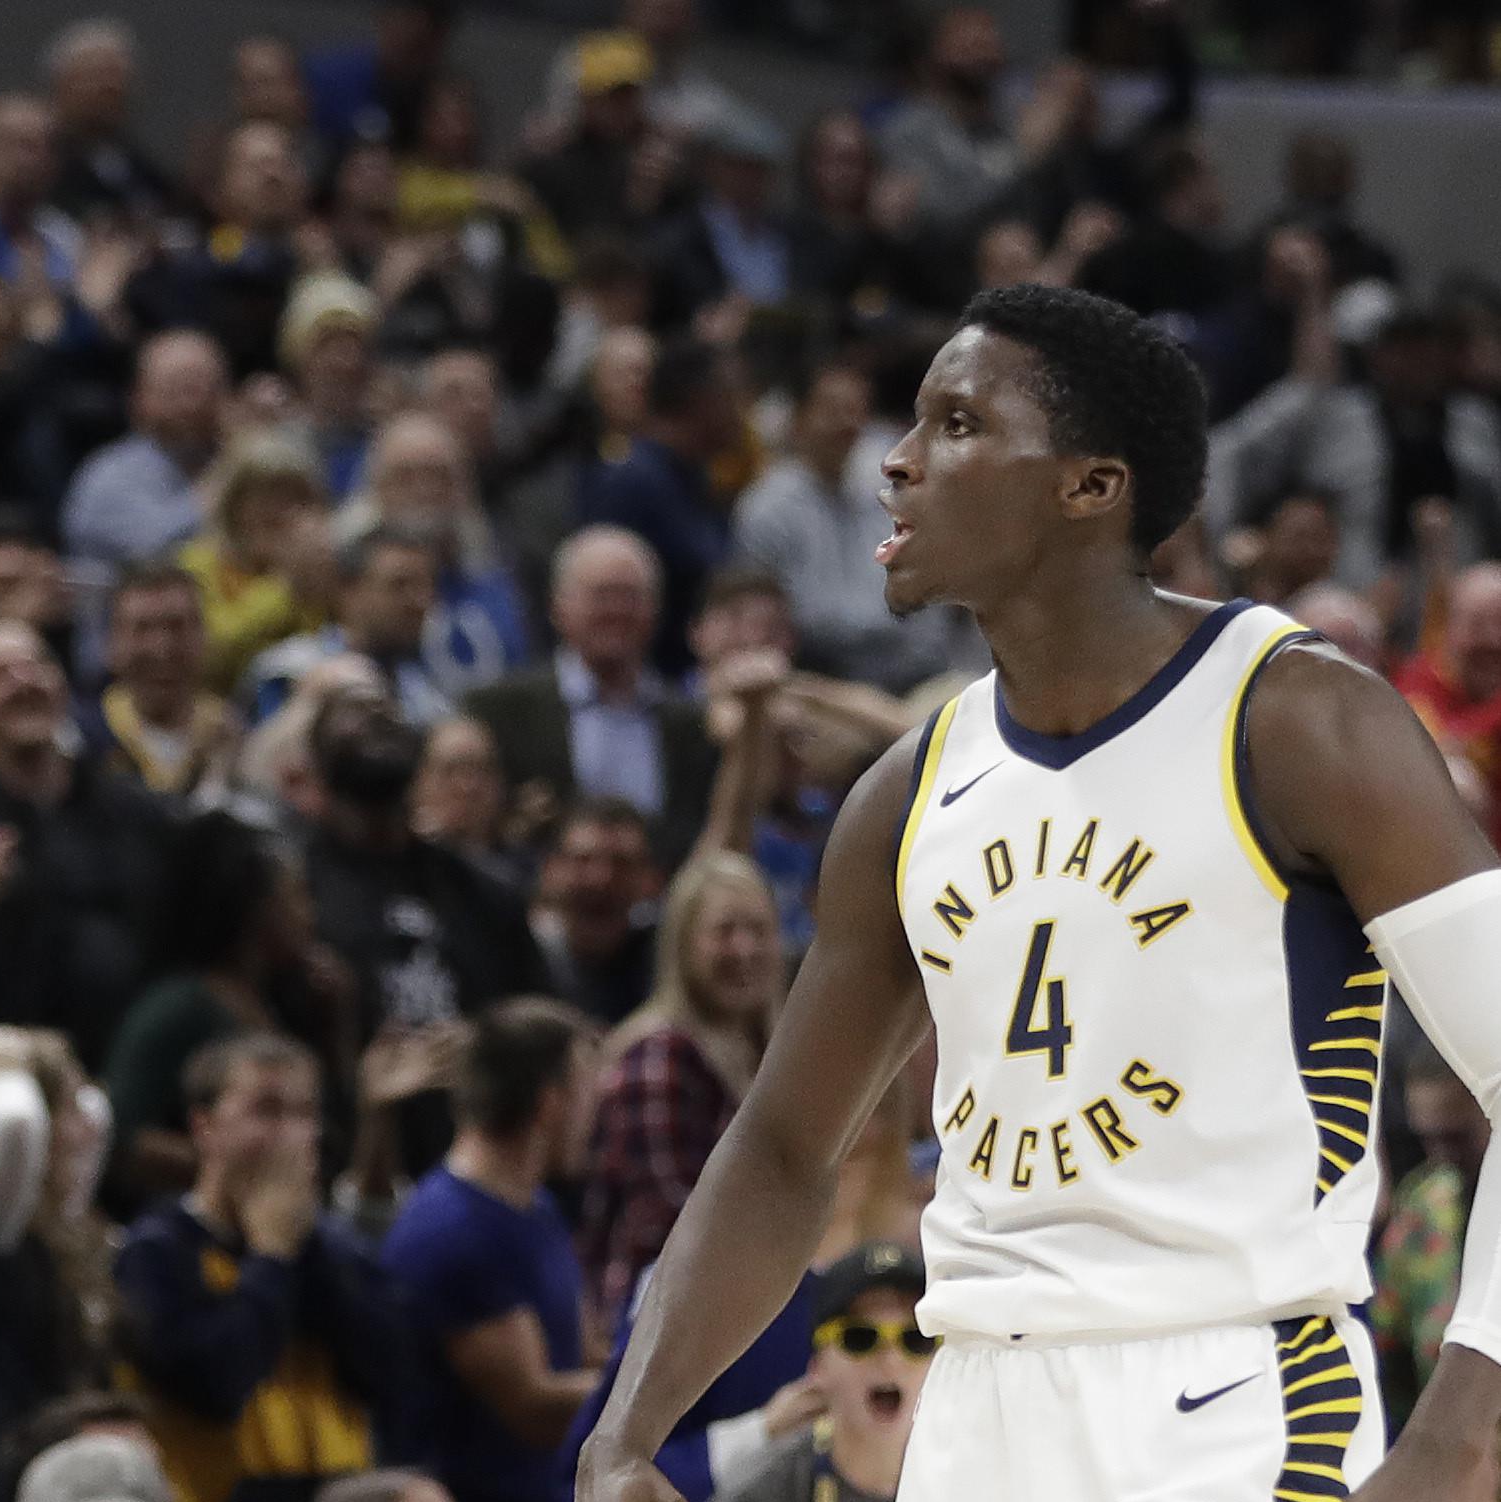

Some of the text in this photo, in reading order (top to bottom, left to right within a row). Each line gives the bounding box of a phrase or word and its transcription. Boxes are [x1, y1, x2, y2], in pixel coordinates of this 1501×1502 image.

[922, 818, 1193, 974] INDIANA
[1005, 918, 1073, 1080] 4
[944, 1060, 1185, 1190] PACERS
